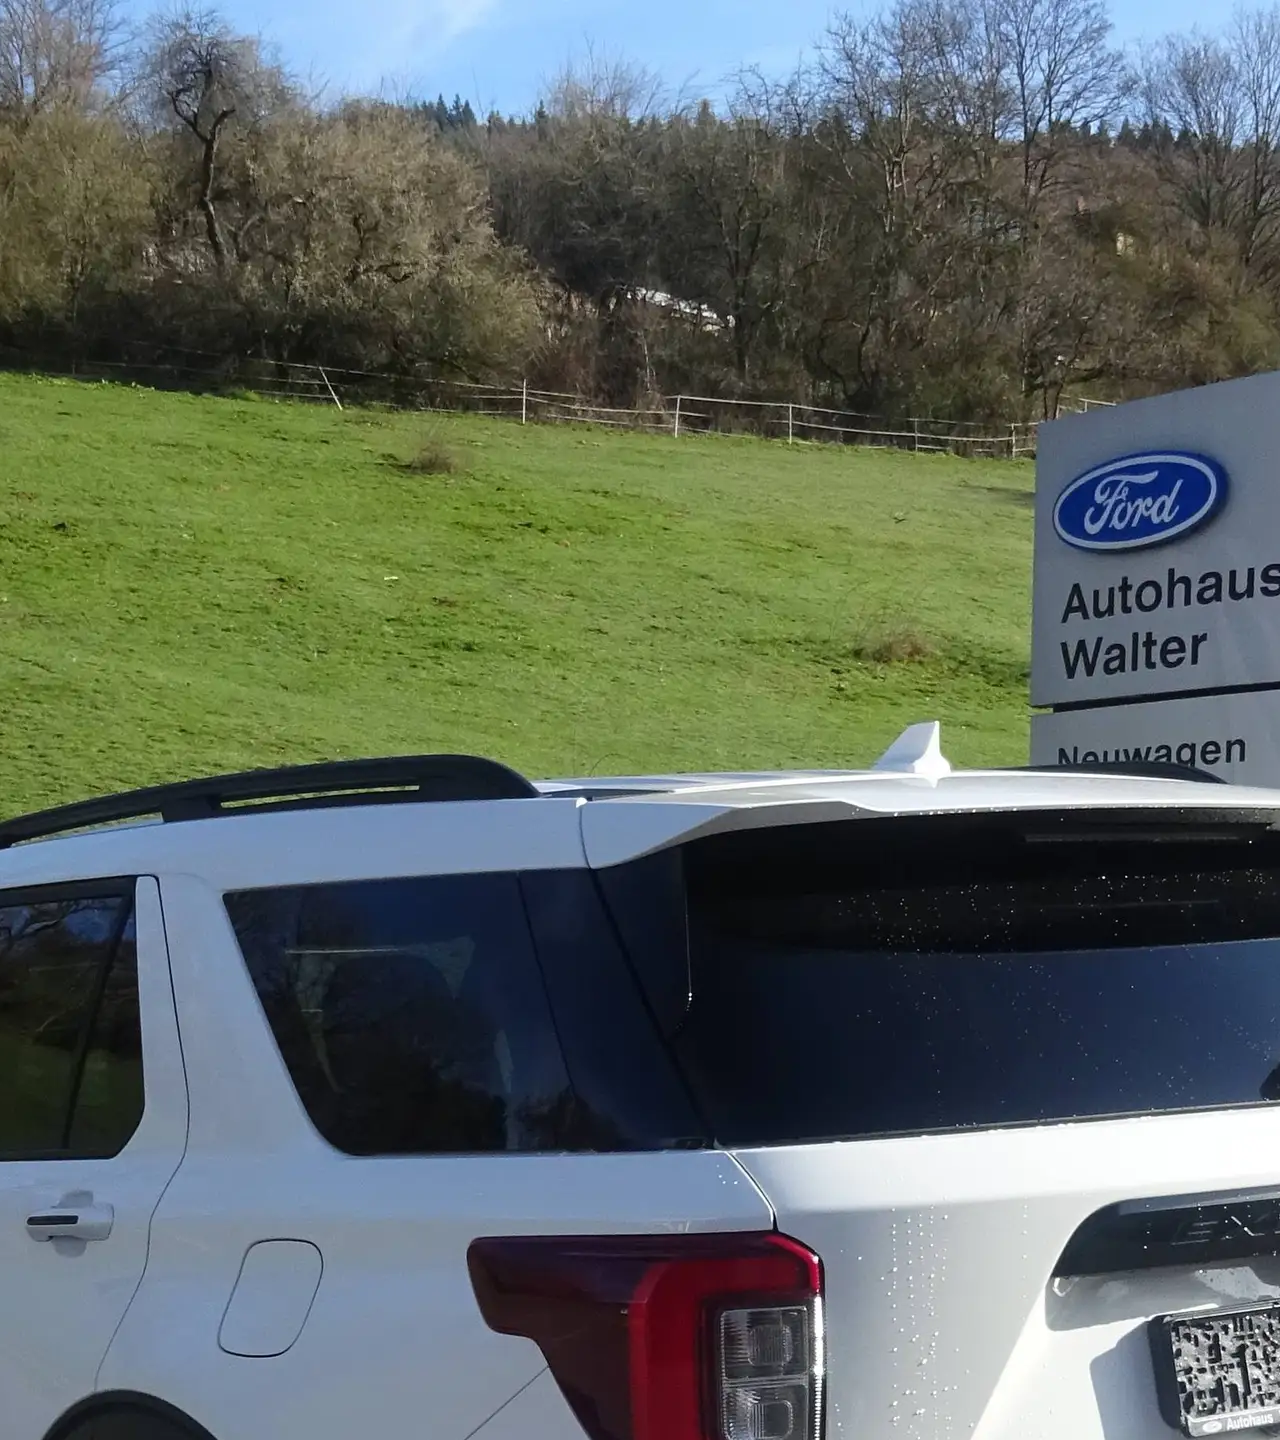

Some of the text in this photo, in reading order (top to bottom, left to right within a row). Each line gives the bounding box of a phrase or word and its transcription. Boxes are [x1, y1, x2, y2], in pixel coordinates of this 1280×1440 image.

[1083, 470, 1184, 535] Ford
[1060, 631, 1208, 680] Walter
[1226, 1412, 1273, 1431] Autohaus
